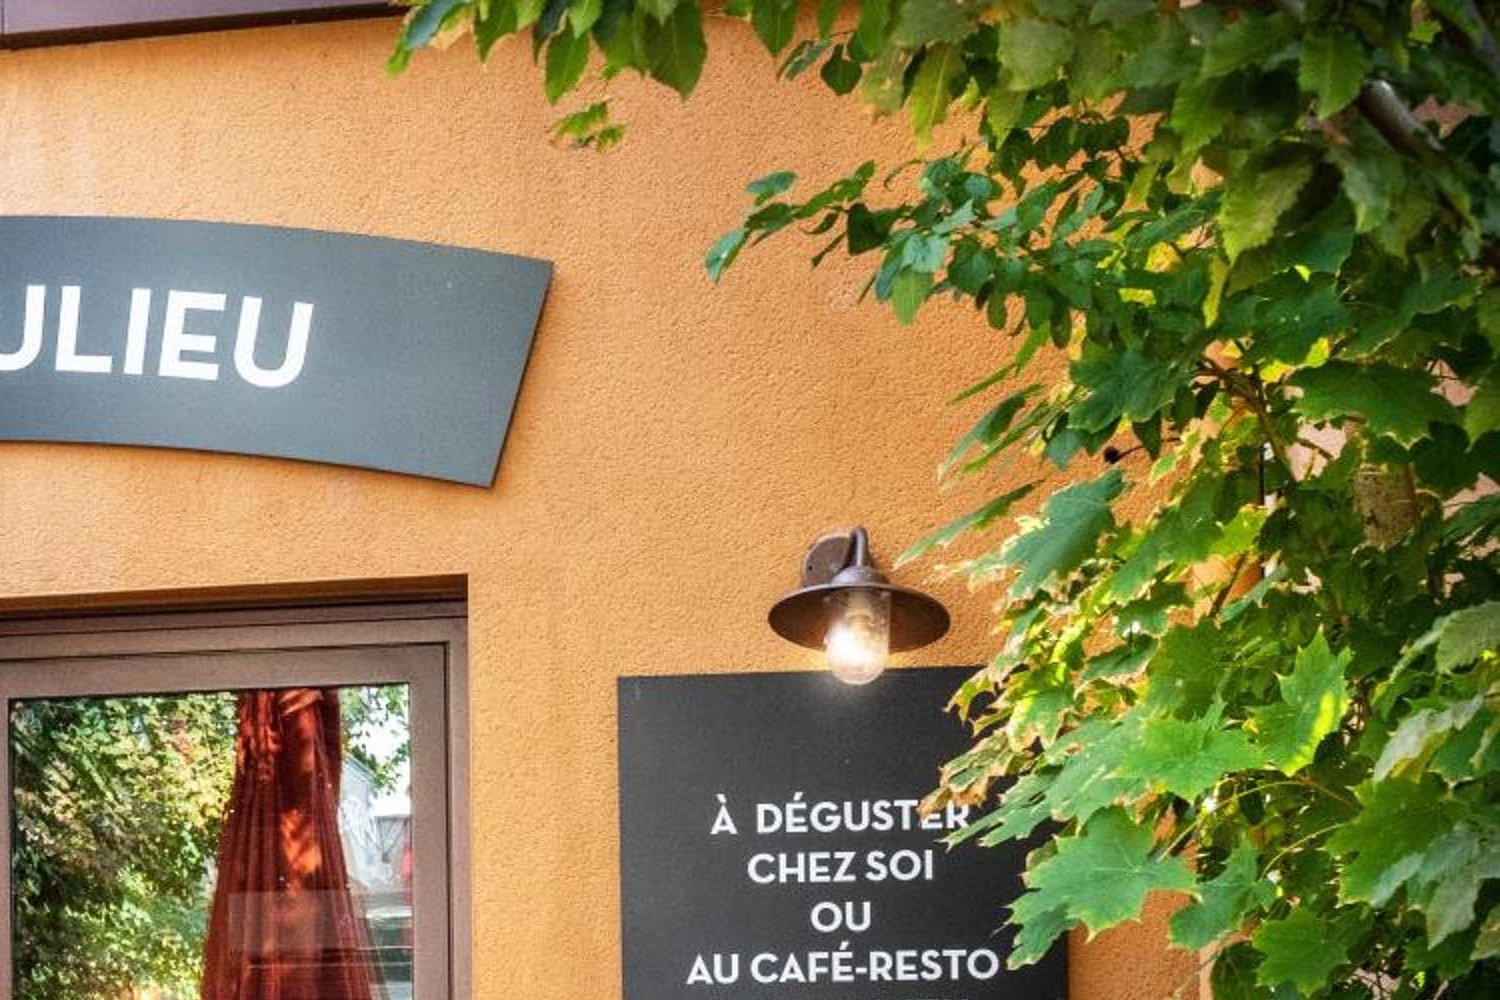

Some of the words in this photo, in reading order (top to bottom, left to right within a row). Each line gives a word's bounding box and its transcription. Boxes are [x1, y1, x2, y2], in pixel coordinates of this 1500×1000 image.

[711, 794, 737, 834] À
[748, 852, 856, 883] CHEZ
[865, 849, 934, 881] SOI
[811, 901, 870, 932] OU
[687, 954, 738, 984] AU
[750, 940, 999, 983] CAFÉ-RESTO
